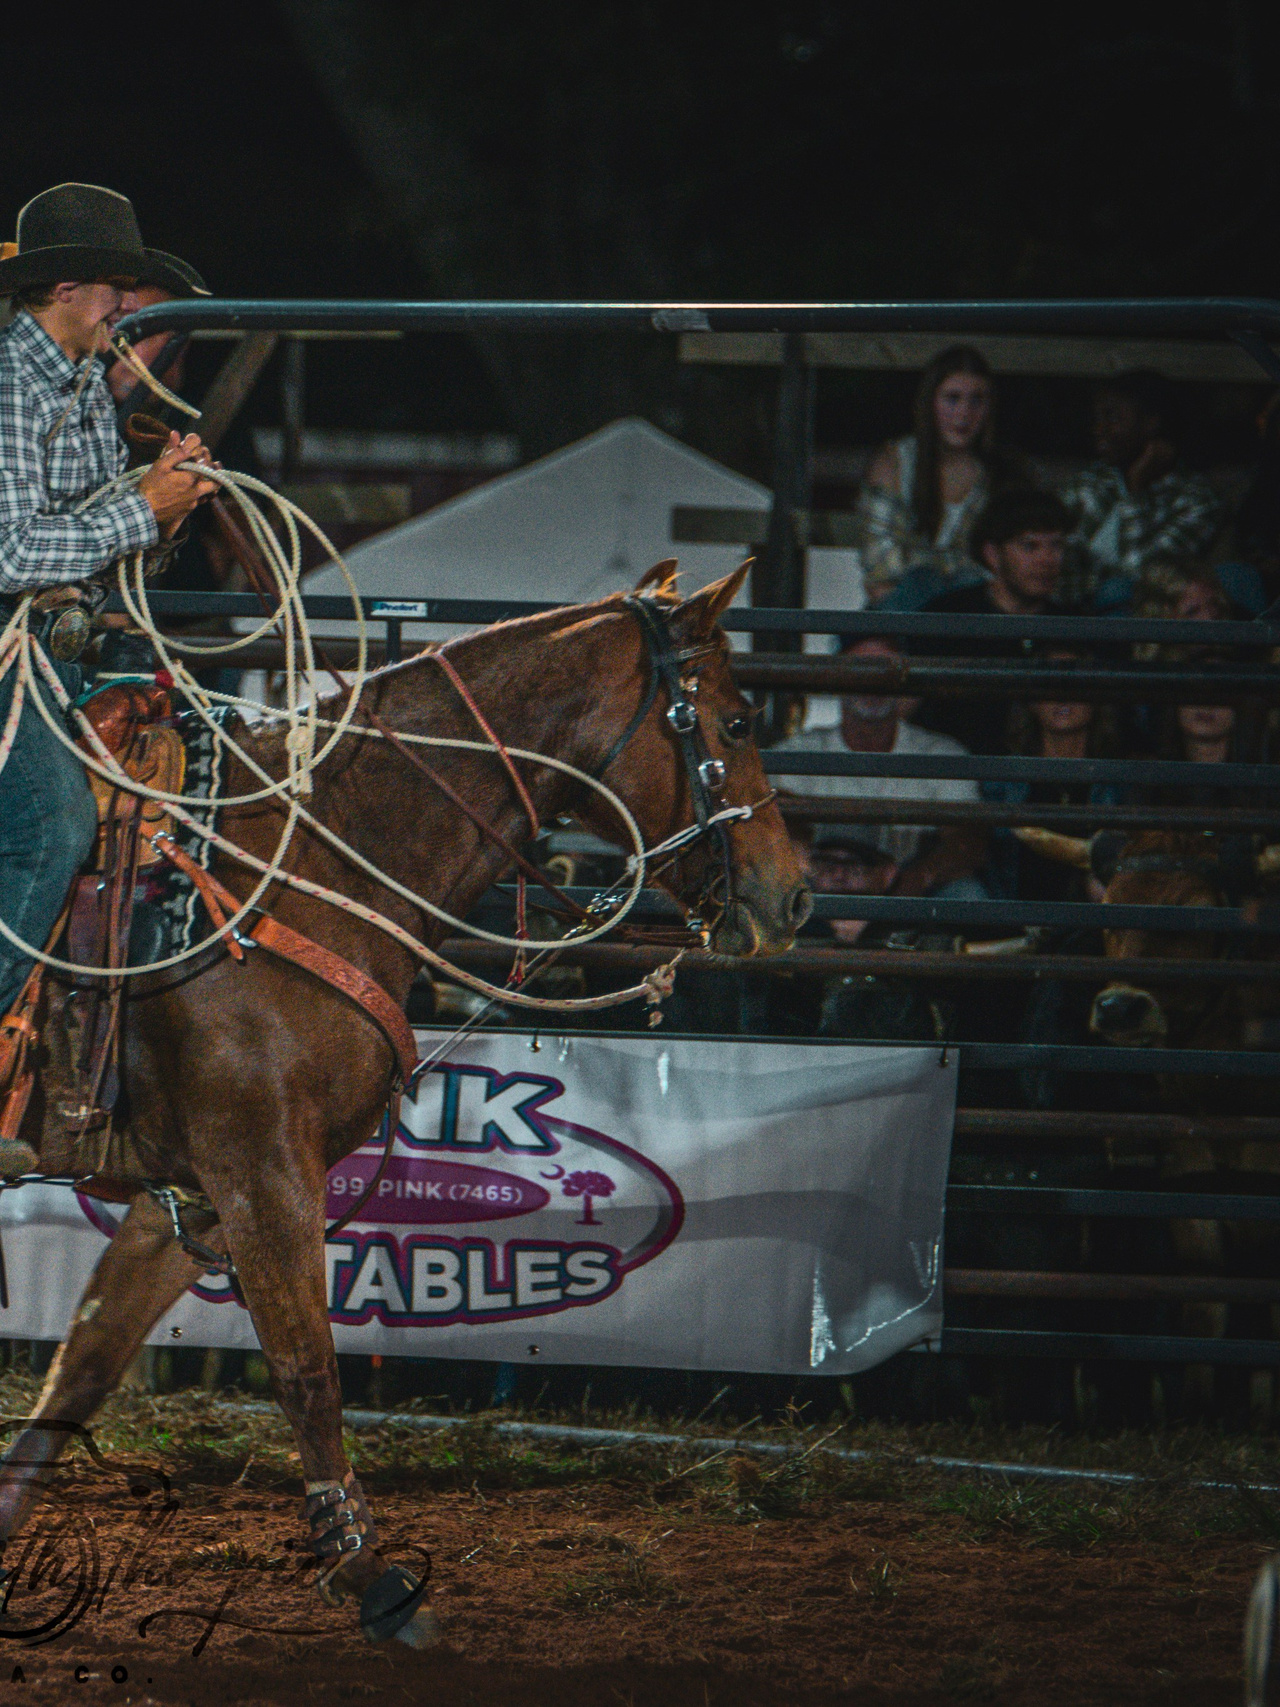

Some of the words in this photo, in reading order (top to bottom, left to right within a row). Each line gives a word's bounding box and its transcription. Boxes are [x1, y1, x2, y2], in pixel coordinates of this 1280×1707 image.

[326, 1175, 365, 1196] 99
[378, 1179, 443, 1200] PINK
[449, 1184, 523, 1204] (7465)
